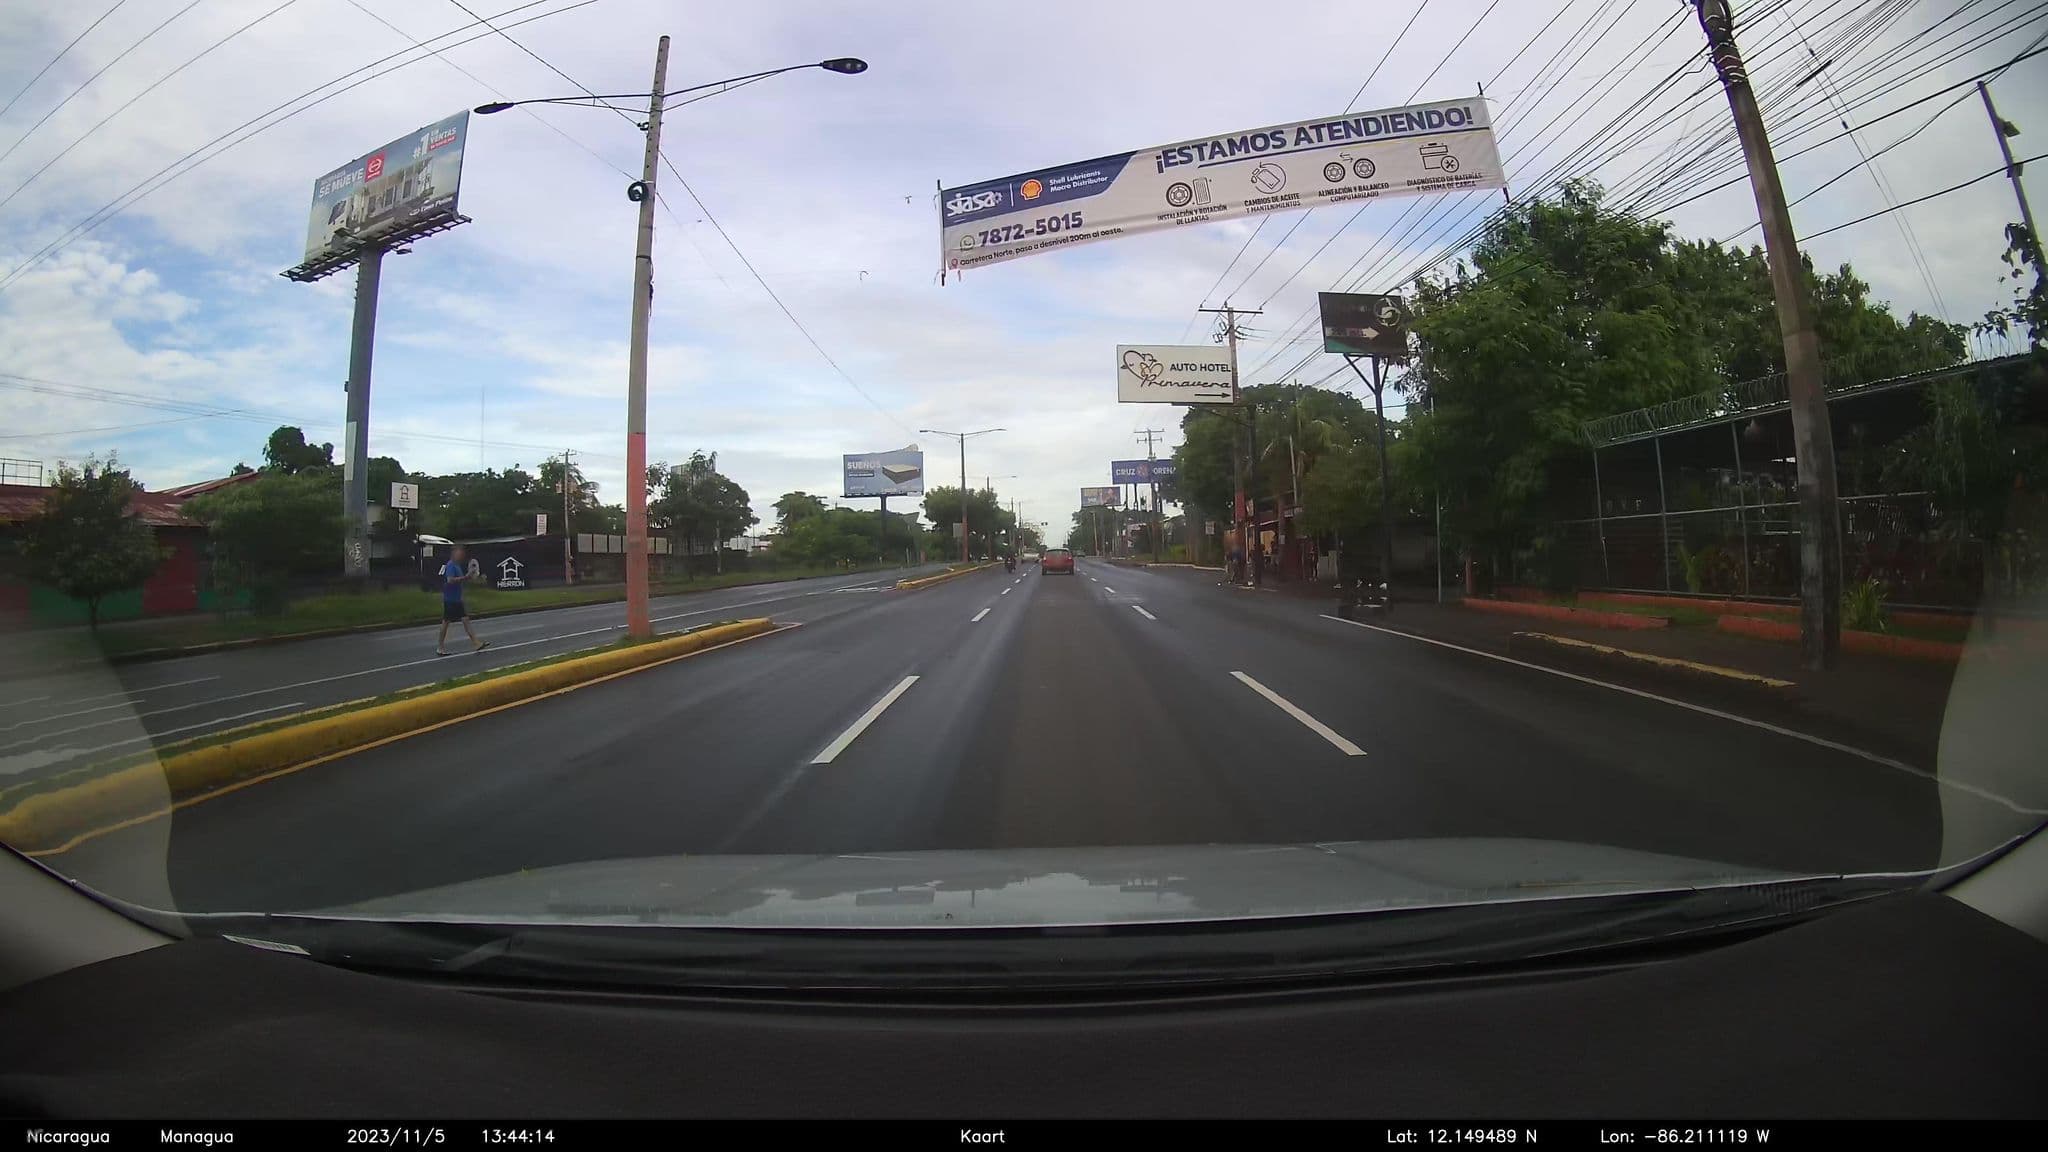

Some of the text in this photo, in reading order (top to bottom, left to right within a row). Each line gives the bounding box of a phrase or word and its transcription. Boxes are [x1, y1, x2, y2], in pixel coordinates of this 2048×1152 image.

[1155, 106, 1474, 174] ¡ESTAMOS ATENDIENDO!
[319, 183, 332, 198] SE
[331, 167, 364, 193] MUEVE
[1050, 170, 1101, 186] Shell Lubricants
[1050, 176, 1110, 193] Macro Distributor
[1406, 176, 1446, 187] DIAGNÓSTICO
[1454, 171, 1483, 181] BATERÍAS
[1318, 185, 1353, 198] ALINEACIÓN
[1358, 182, 1390, 192] BALANCEO
[1420, 183, 1446, 192] SISTEMA
[946, 191, 997, 217] siasa
[1244, 192, 1301, 207] CAMBIOS DE ACEITE
[1330, 190, 1379, 202] COMPUTARIZADO
[1157, 209, 1194, 221] INSTALACIÓN
[1198, 203, 1228, 215] ROTACIÓN
[1250, 200, 1301, 212] MANTENIMIENTOS
[1184, 214, 1210, 224] LLANTAS
[978, 210, 1084, 247] 7872-5015
[959, 254, 993, 266] Carretera
[993, 248, 1015, 258] Norte,
[1015, 244, 1033, 254] paso
[1039, 236, 1070, 248] desnivel
[1069, 232, 1092, 242] 200m
[1092, 230, 1100, 238] al
[1169, 363, 1232, 373] AUTO HOTEL
[1140, 373, 1232, 388] Primavera
[1116, 468, 1136, 476] CRUZ
